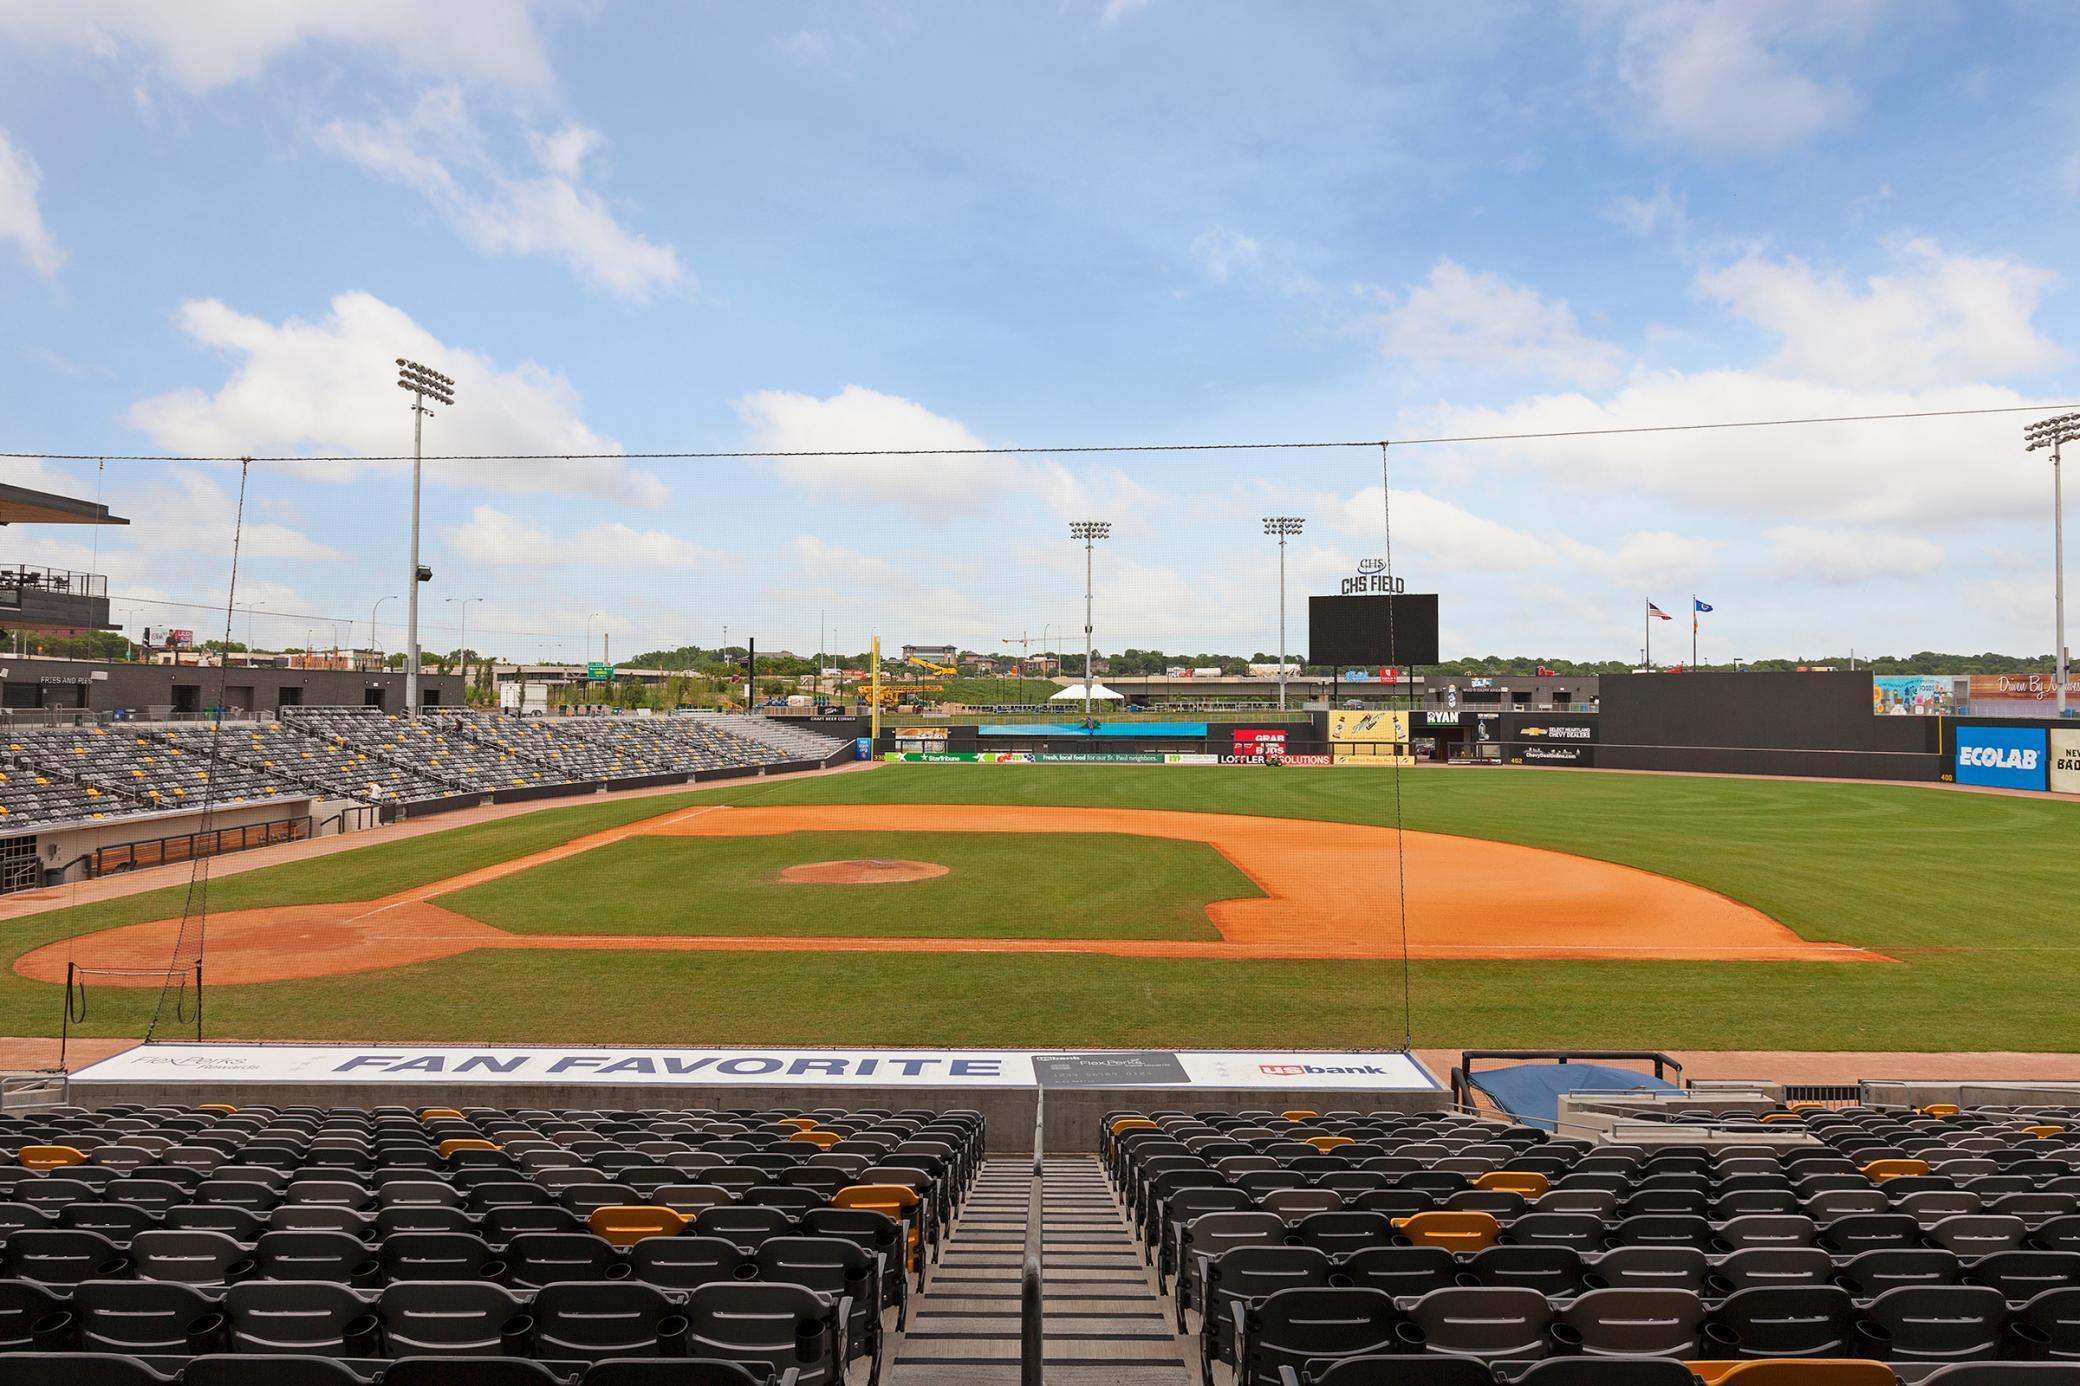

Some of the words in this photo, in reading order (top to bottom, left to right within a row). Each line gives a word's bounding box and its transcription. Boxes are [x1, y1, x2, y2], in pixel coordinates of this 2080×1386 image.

[1360, 559, 1384, 568] CHS
[1341, 576, 1367, 595] CHS
[1371, 575, 1404, 593] FIELD
[41, 676, 61, 684] FRIES
[62, 677, 77, 685] AND
[1999, 676, 2026, 692] Driven
[2029, 675, 2045, 700] By
[1427, 711, 1459, 723] RYAN
[1129, 754, 1157, 763] neighbors.
[1221, 755, 1265, 764] LOFFLER
[1279, 755, 1330, 764] SOLUTIONS
[1960, 746, 2037, 770] ECOLAB
[331, 1056, 531, 1073] FAN
[545, 1056, 1001, 1077] FAVORITE
